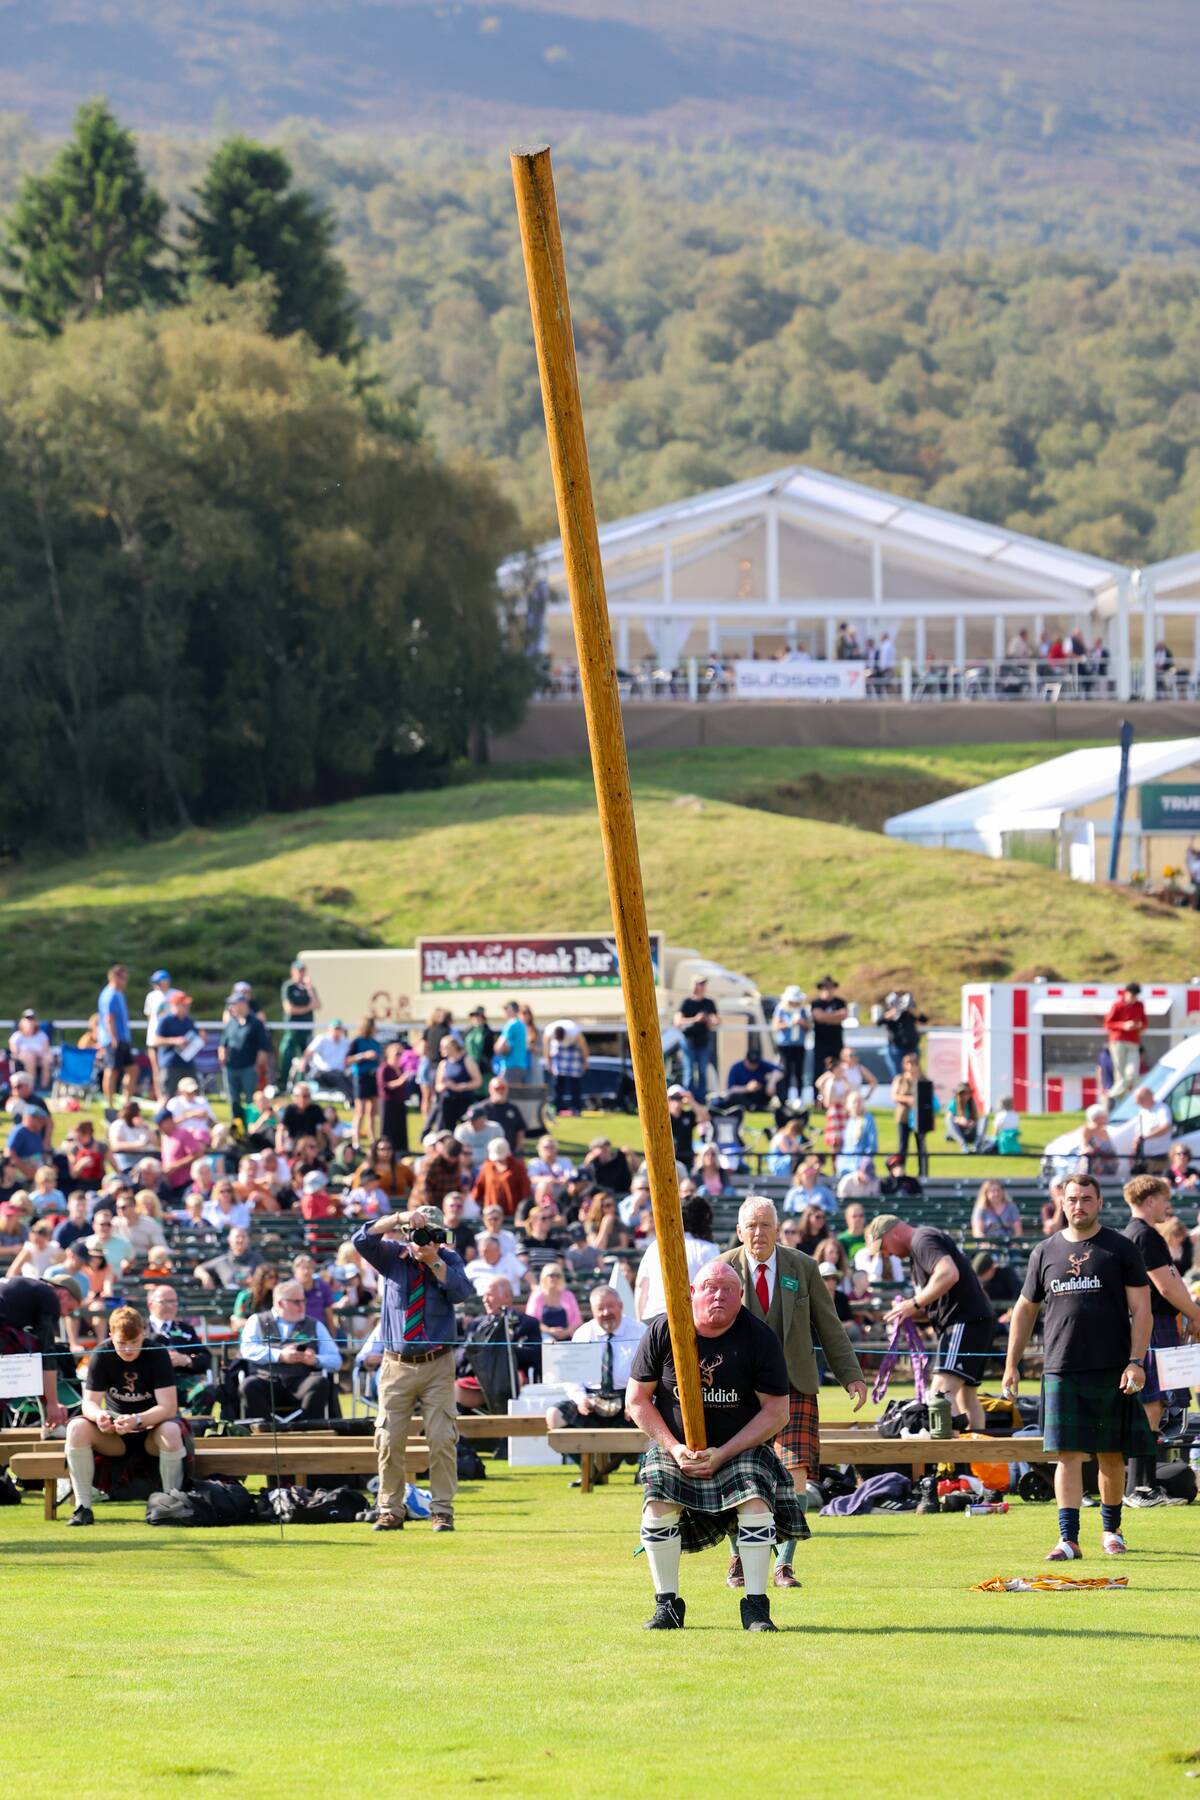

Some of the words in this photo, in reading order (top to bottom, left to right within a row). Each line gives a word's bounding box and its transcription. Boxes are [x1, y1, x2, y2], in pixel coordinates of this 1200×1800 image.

[740, 672, 840, 688] subsea
[846, 671, 860, 688] 7
[424, 948, 513, 981] Highland
[514, 946, 573, 974] Steak
[574, 946, 613, 973] Bar
